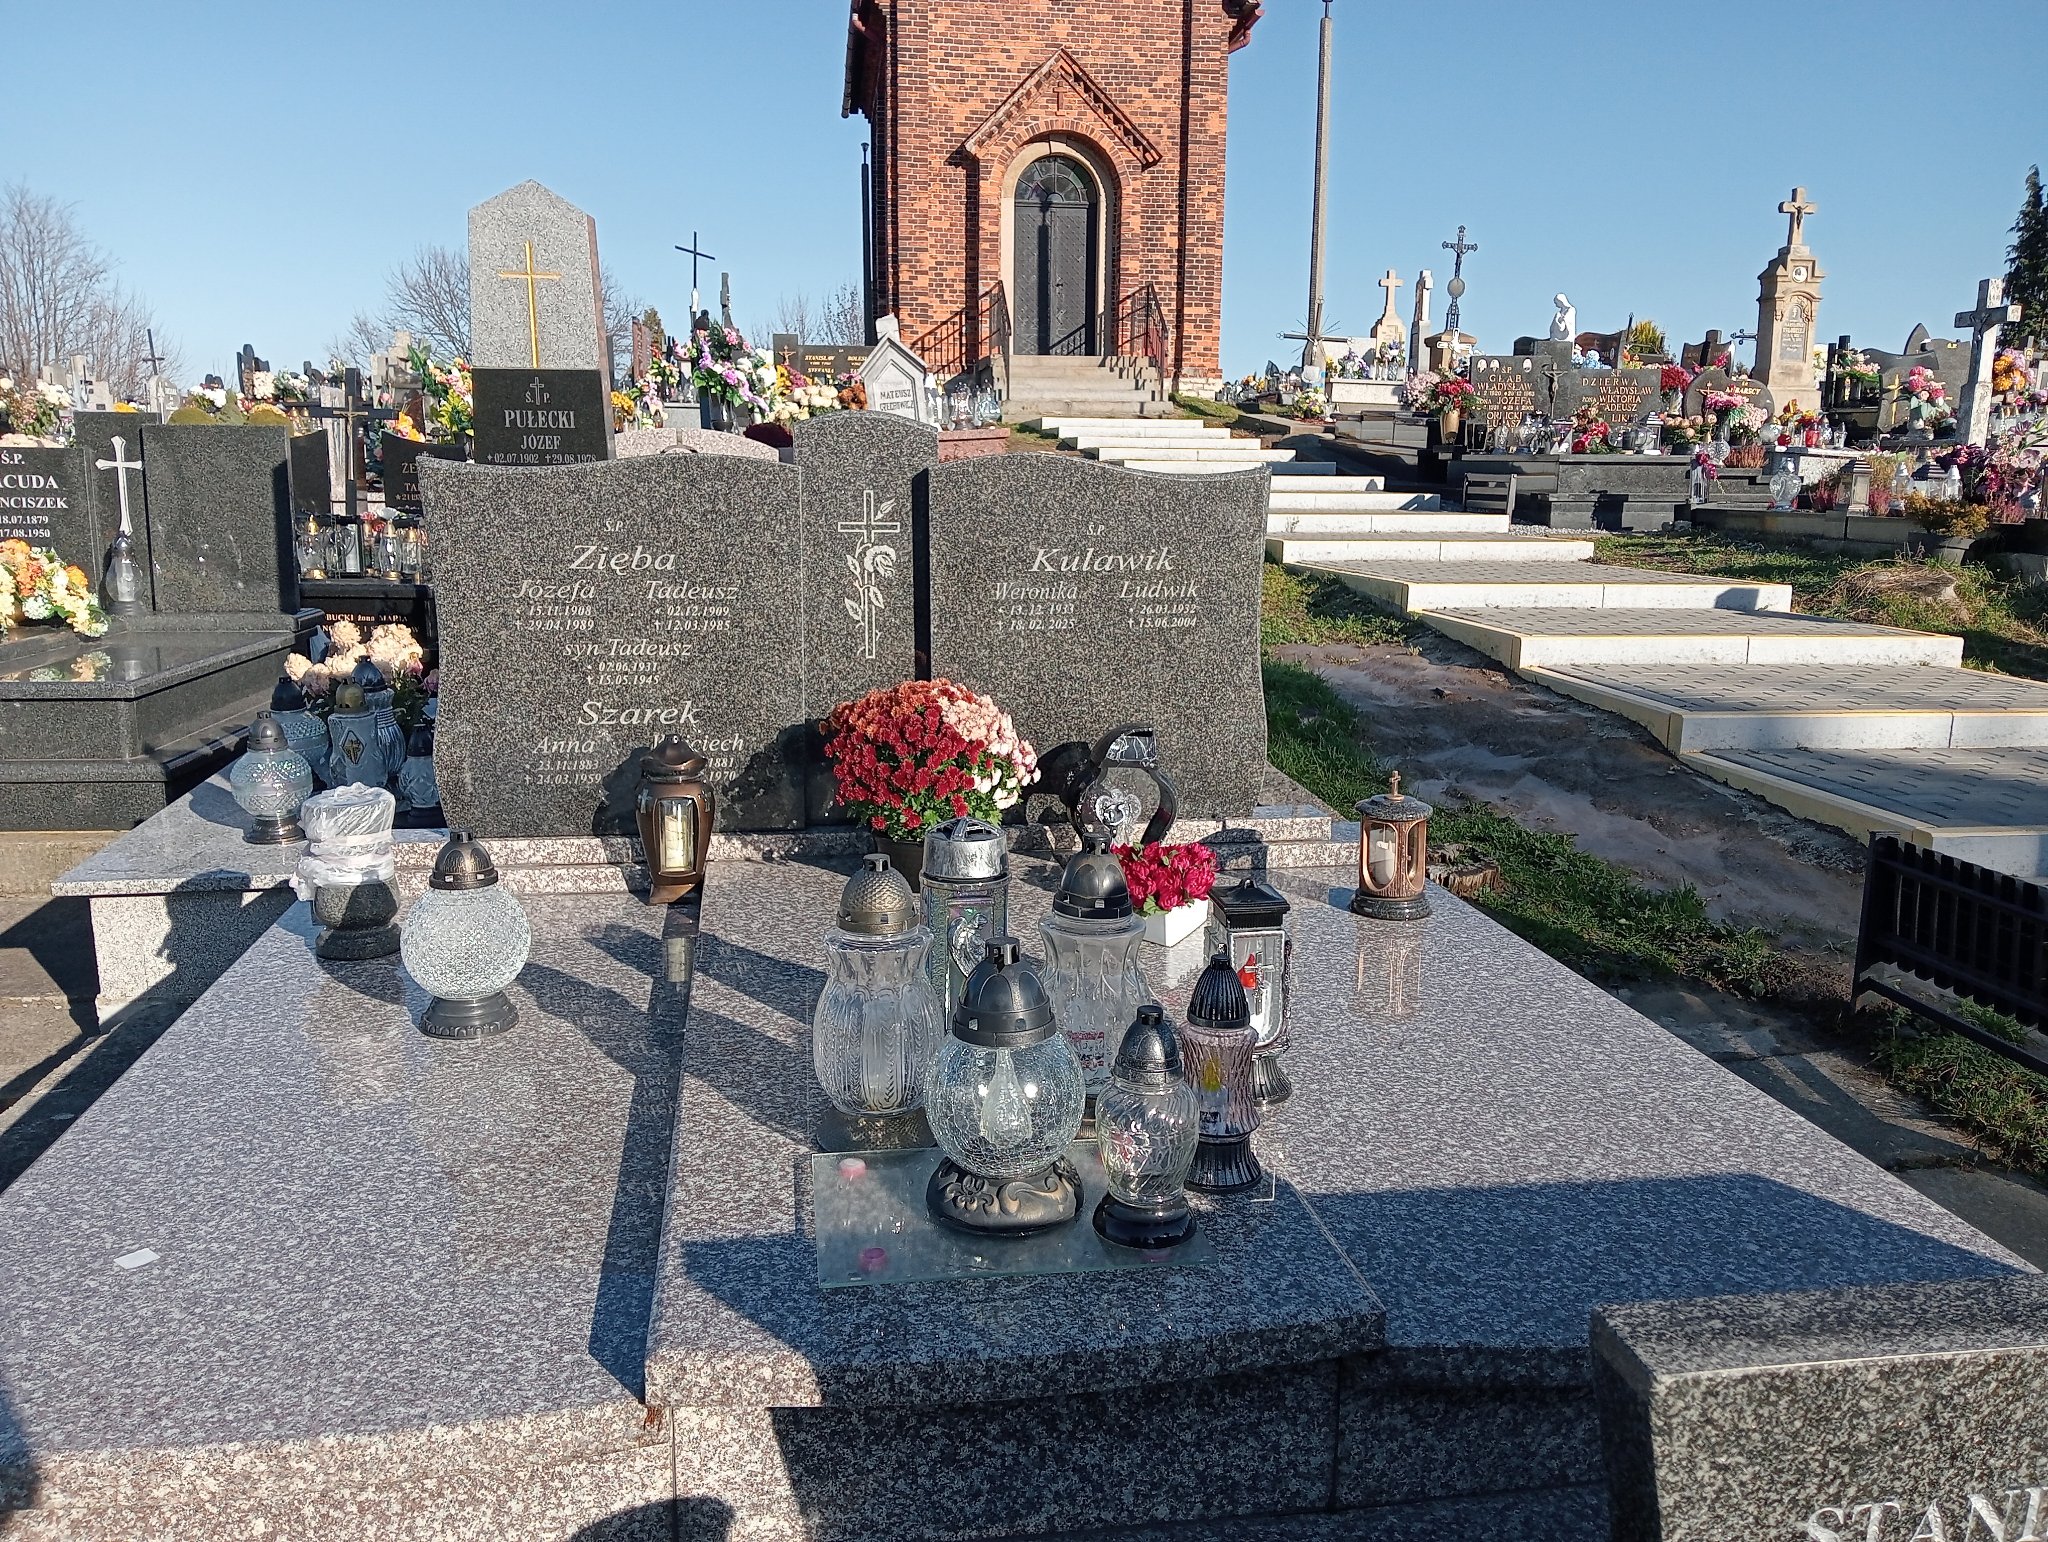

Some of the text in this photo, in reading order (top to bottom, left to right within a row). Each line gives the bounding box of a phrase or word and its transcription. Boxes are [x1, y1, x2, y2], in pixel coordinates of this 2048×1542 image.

[1582, 378, 1638, 386] DZIERWA
[880, 389, 911, 399] MATEUSZ
[1600, 386, 1653, 395] WŁADYSŁAW
[1599, 395, 1642, 403] WIKTORIA
[504, 409, 576, 429] PUŁECKI
[520, 433, 562, 450] JÓZEF
[0, 450, 25, 464] Ś.P.
[494, 454, 539, 464] 02.07.1902
[568, 545, 676, 576] Zięba
[1026, 547, 1177, 572] Kulawik
[512, 579, 739, 604] Józefa Tadeusz
[994, 580, 1201, 600] Weronika Ludwik
[528, 619, 731, 630] 29.04.1989 12.03.1985
[1138, 617, 1197, 628] 15.06.2004
[563, 638, 693, 660] syn Tadeusz
[598, 674, 660, 686] 15.05.1945
[578, 701, 701, 726] Szarek
[532, 736, 596, 754] Anna
